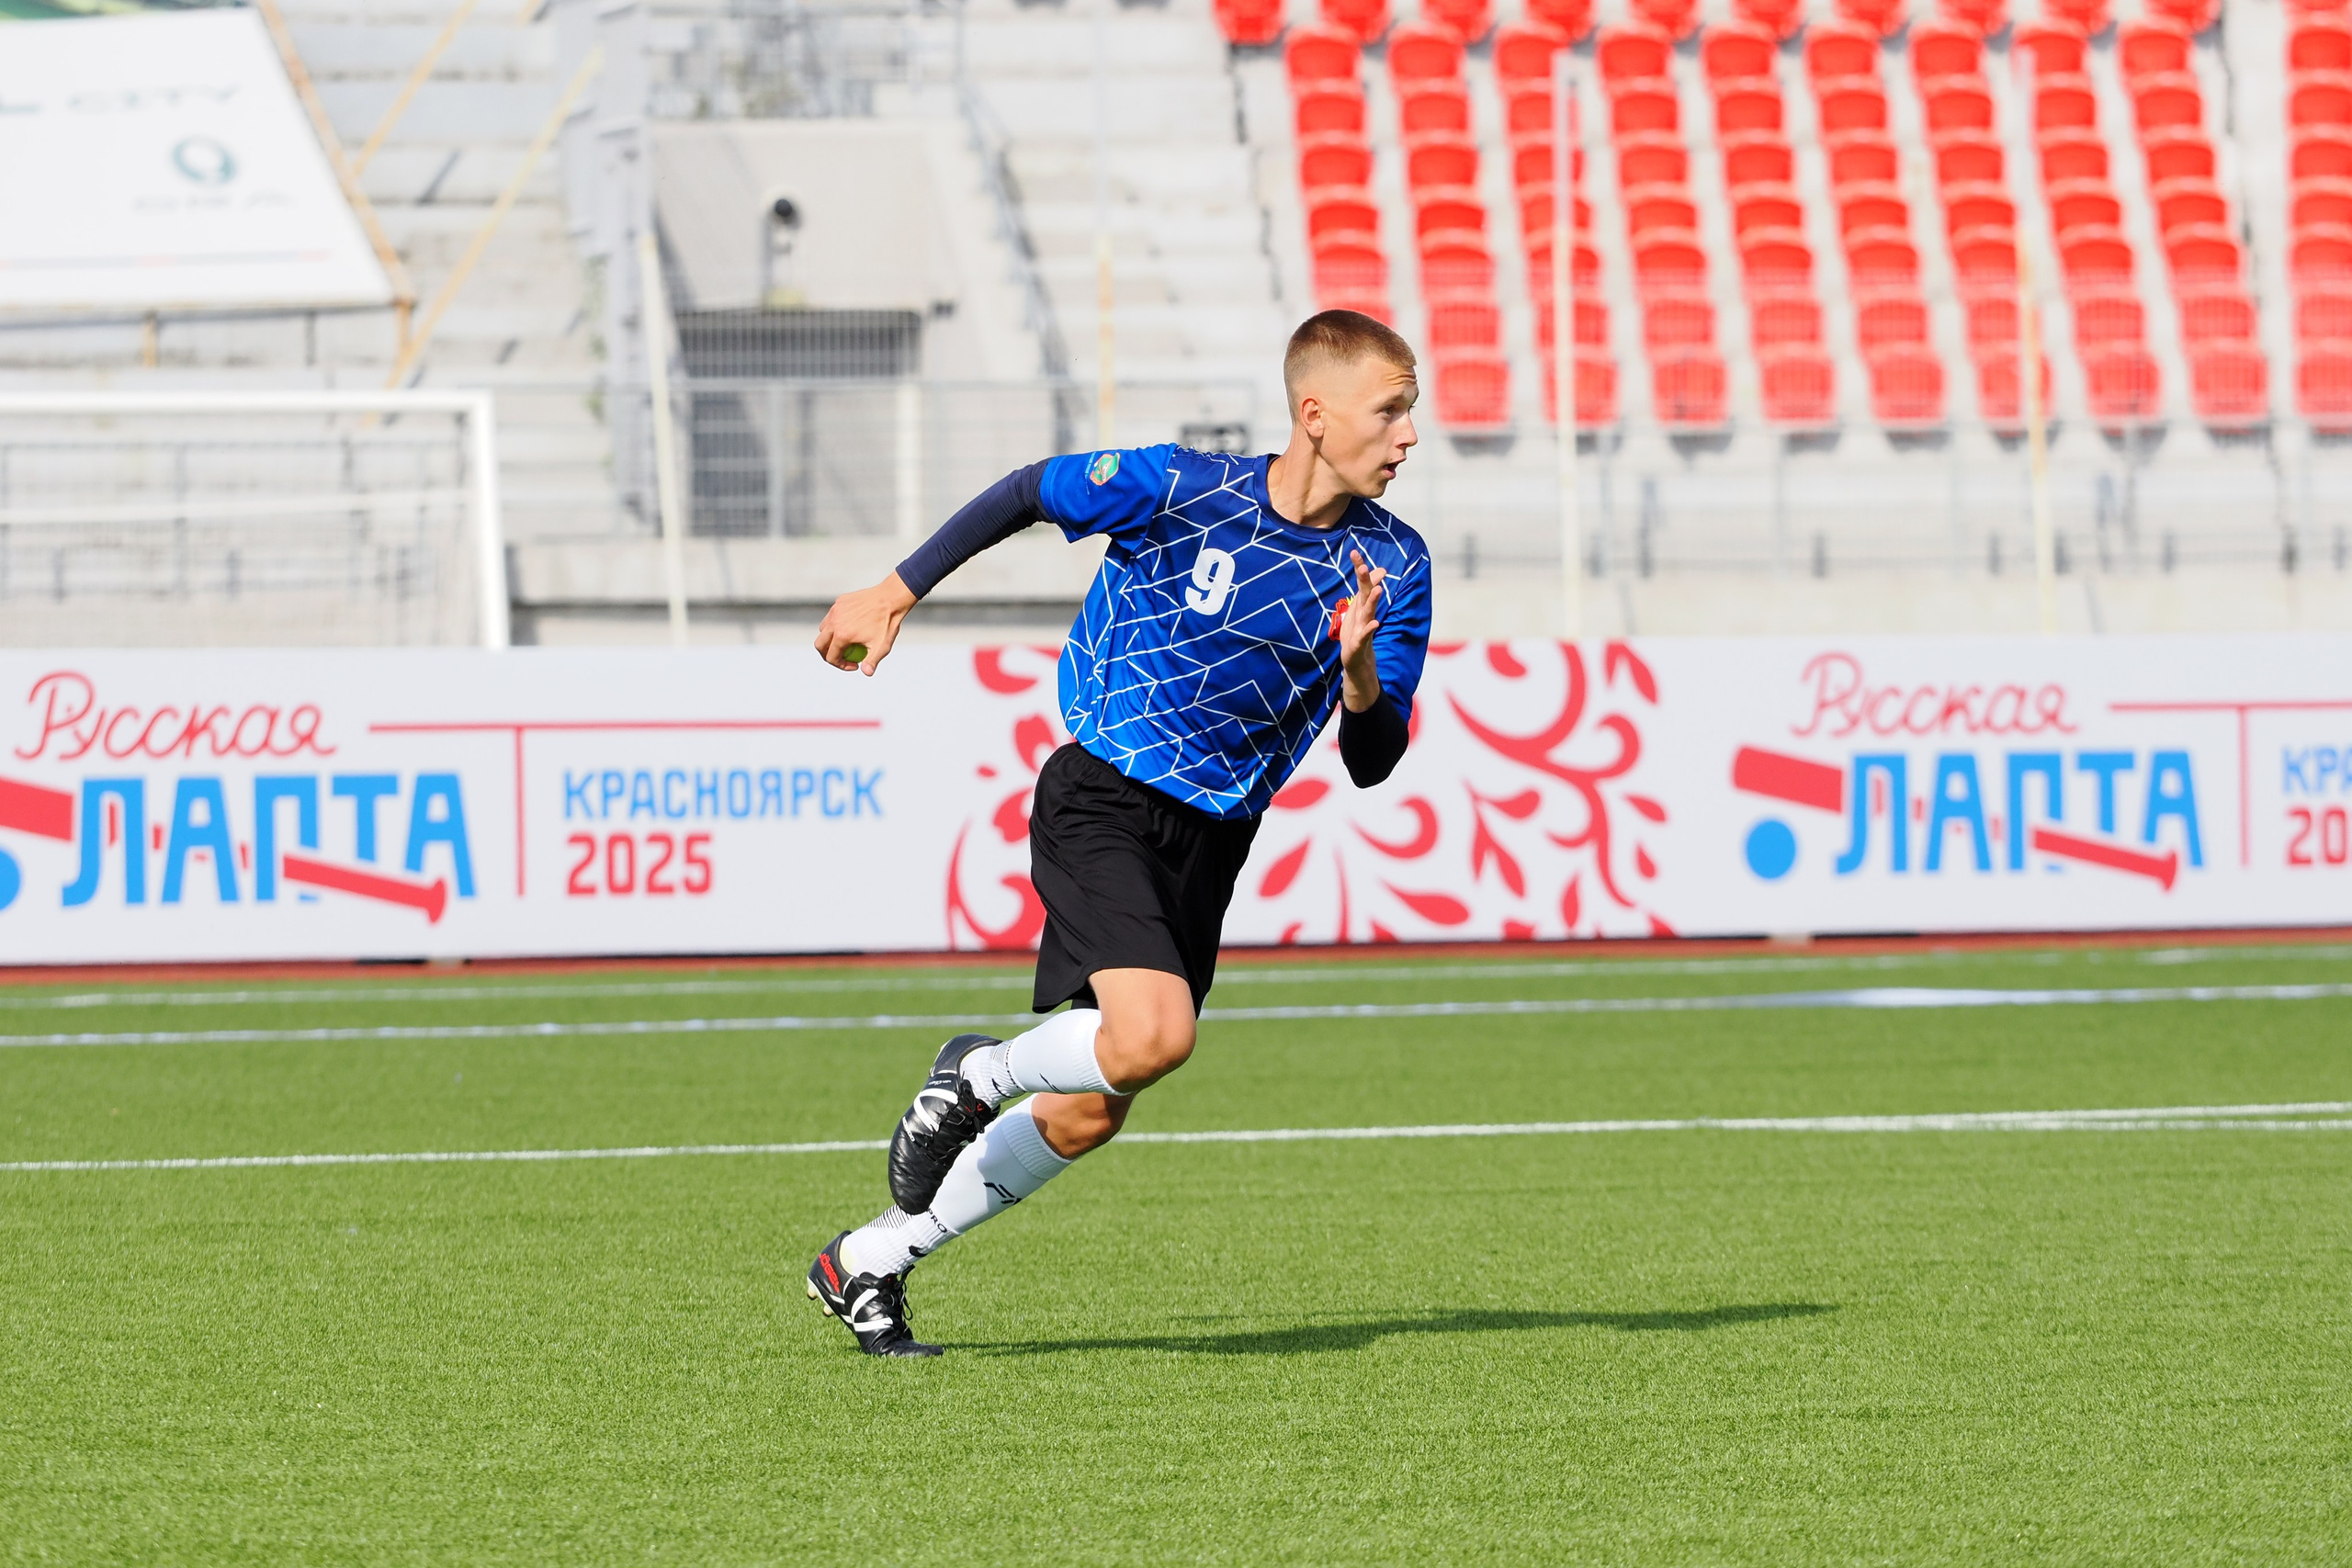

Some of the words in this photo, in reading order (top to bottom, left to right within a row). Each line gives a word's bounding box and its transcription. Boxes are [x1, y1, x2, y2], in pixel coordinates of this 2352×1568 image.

[1185, 548, 1236, 615] 9
[15, 671, 336, 761] Русская
[1792, 653, 2077, 737] Русская
[563, 768, 883, 820] КРАСНОЯРСК
[1834, 750, 2205, 876] ЛАПТА
[62, 772, 477, 908] ЛАПТА
[566, 831, 714, 897] 2025
